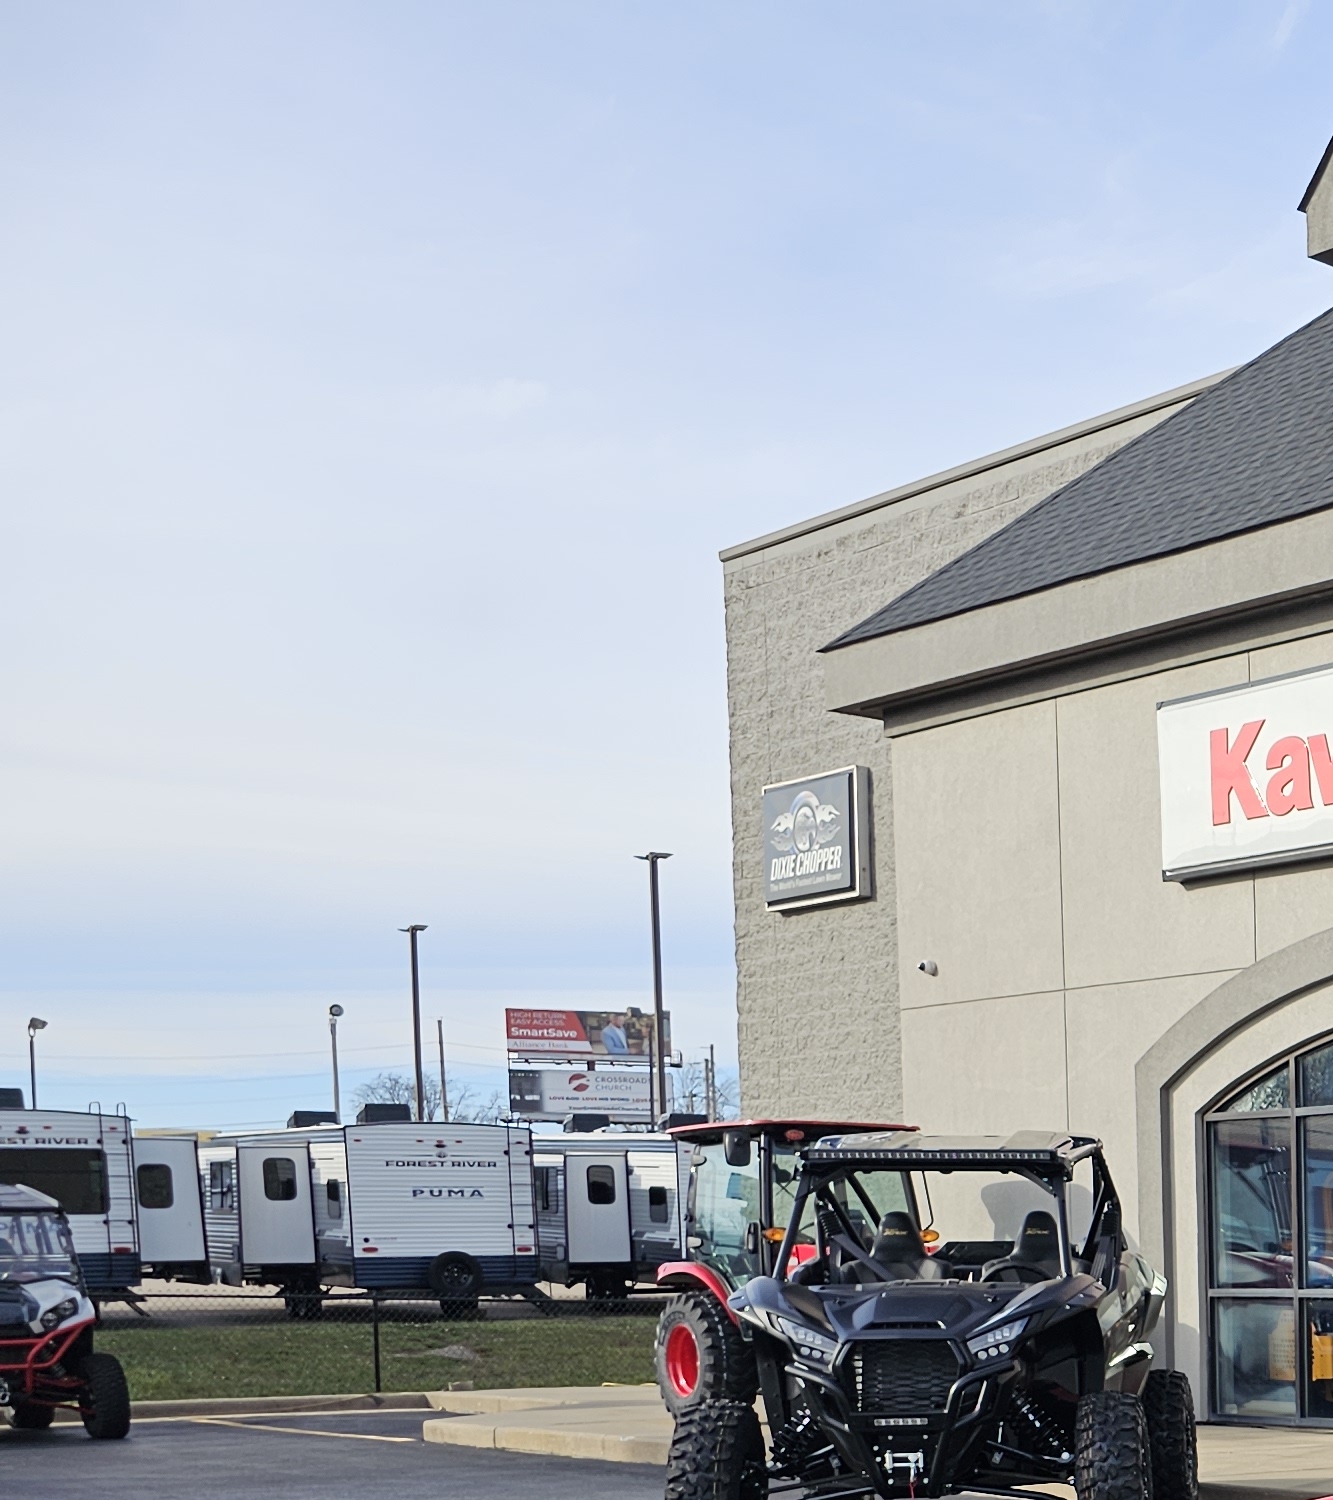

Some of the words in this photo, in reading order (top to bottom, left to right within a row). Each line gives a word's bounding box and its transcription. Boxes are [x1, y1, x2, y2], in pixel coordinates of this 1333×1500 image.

[770, 853, 796, 881] DIXIE
[796, 845, 842, 876] CHOPPER
[511, 1027, 577, 1038] SmartSave
[451, 1160, 497, 1168] RIVER
[412, 1189, 484, 1197] PUMA
